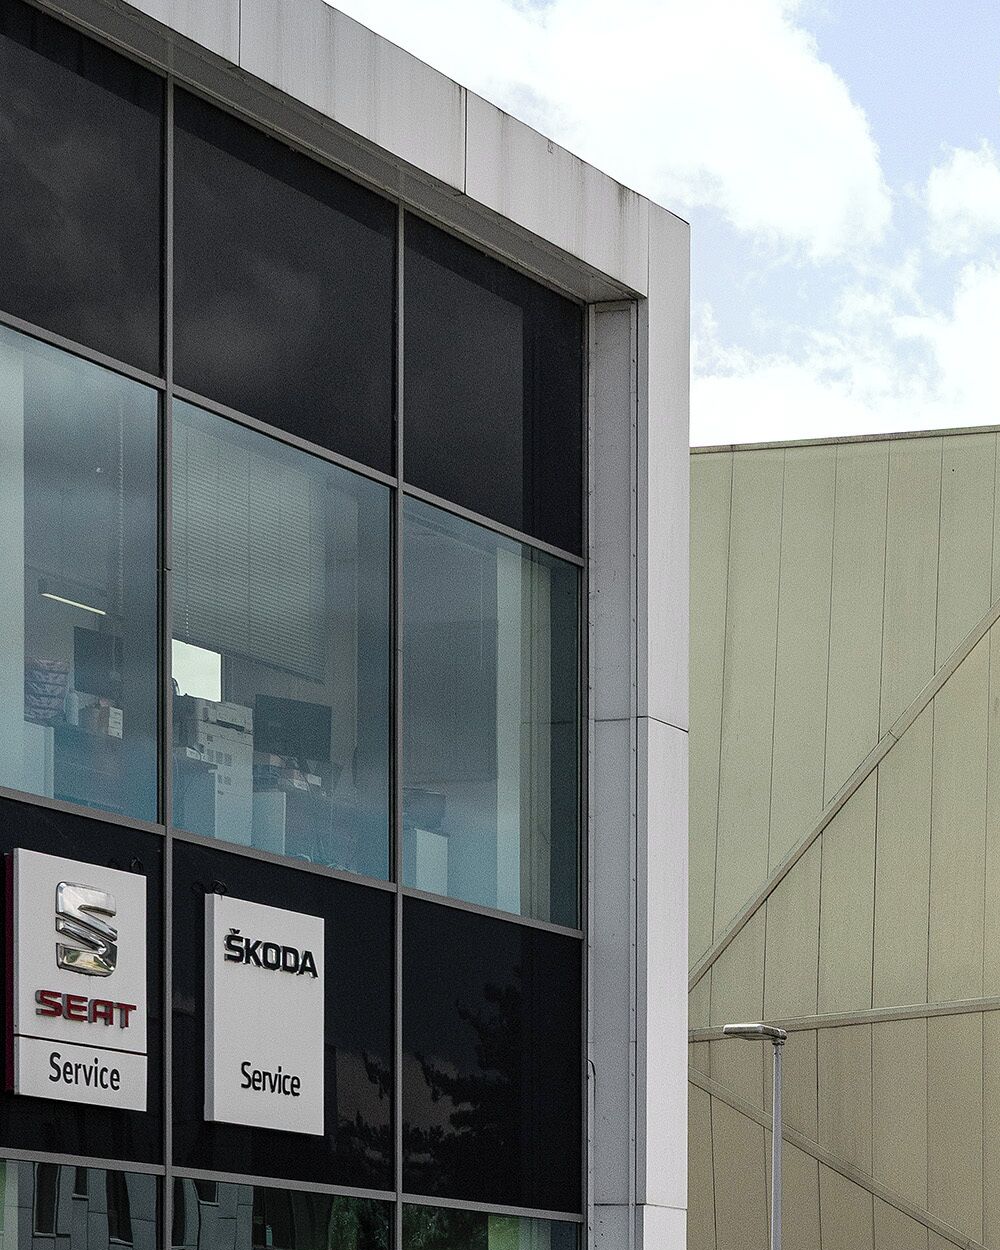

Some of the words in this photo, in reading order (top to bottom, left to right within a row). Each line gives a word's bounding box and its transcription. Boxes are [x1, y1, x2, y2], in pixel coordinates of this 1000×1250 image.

[224, 928, 319, 979] ŠKODA
[35, 989, 137, 1029] SEAT
[49, 1052, 121, 1091] Service
[240, 1061, 301, 1097] Service
